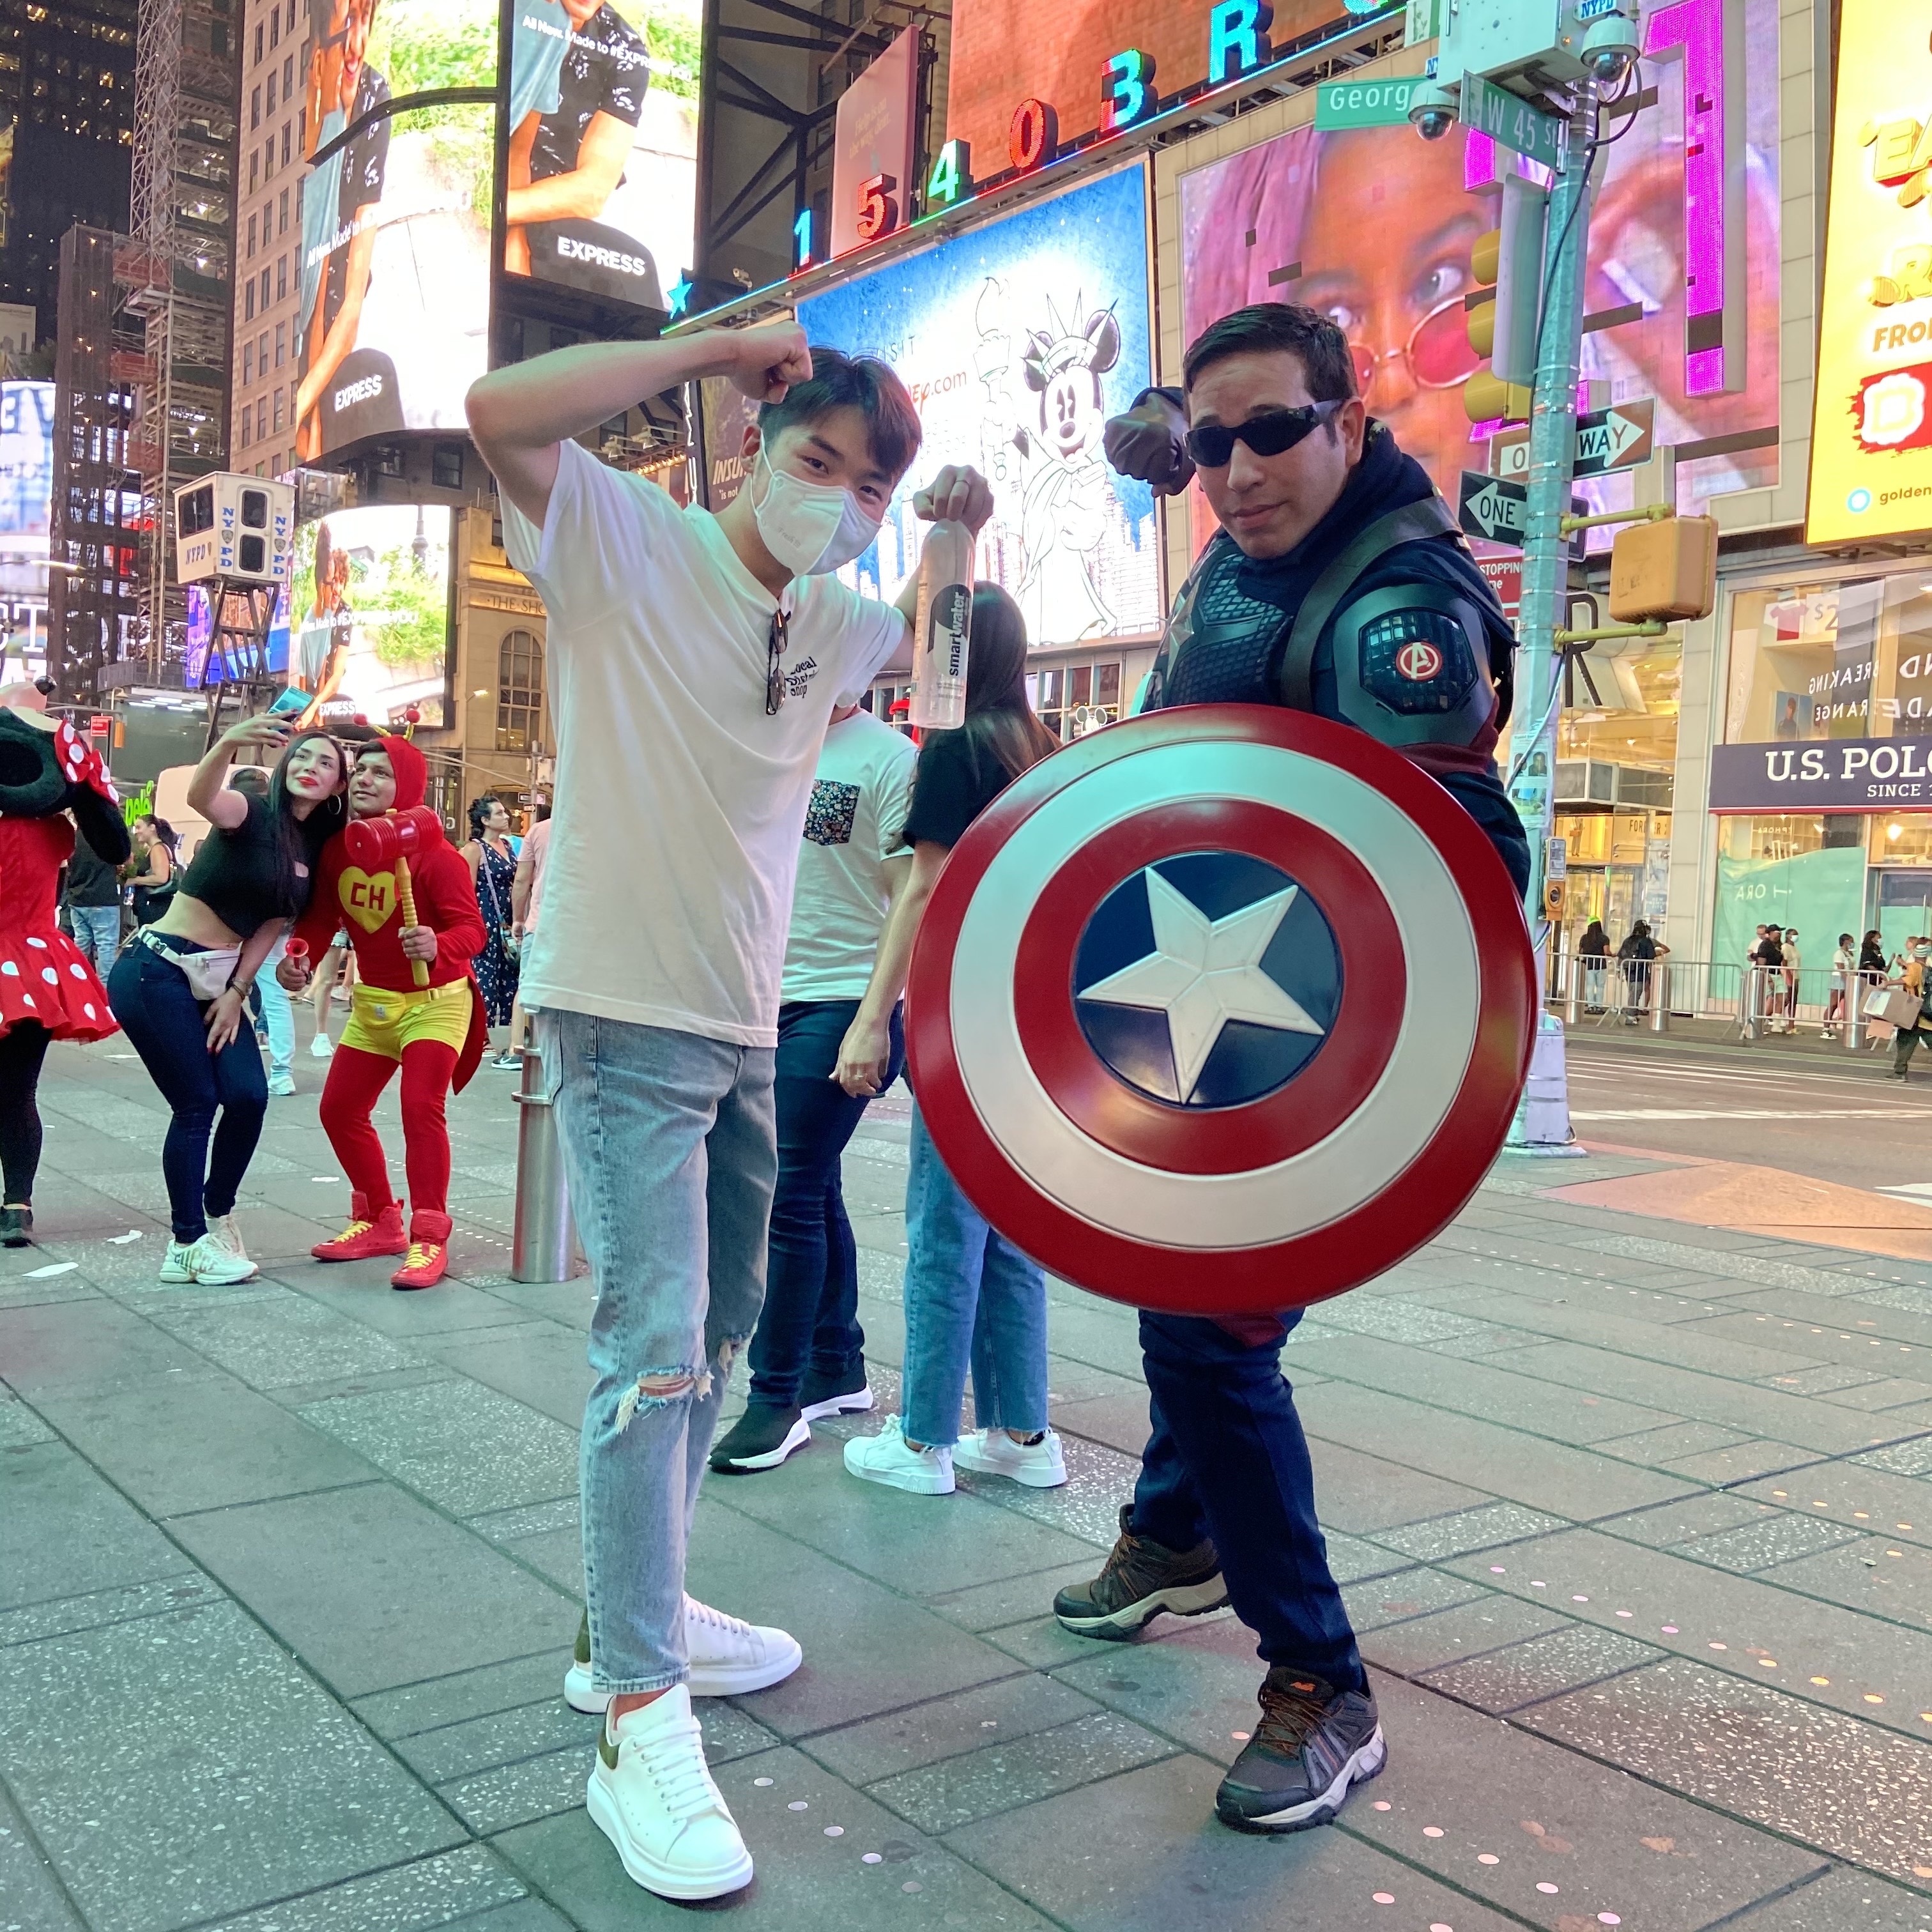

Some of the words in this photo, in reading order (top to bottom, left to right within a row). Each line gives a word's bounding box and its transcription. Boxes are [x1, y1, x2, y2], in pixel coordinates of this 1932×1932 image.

[565, 28, 595, 49] Made
[597, 41, 608, 54] to
[1330, 86, 1409, 111] Georg
[1488, 91, 1505, 135] W
[1514, 109, 1535, 151] 45
[557, 236, 645, 276] EXPRESS
[1873, 318, 1932, 352] FRO
[335, 374, 382, 412] EXPRESS
[1579, 424, 1628, 457] WAY
[713, 456, 747, 486] INSU
[728, 486, 738, 498] not
[1480, 495, 1516, 526] ONE
[186, 544, 206, 565] NYPD
[1479, 562, 1522, 576] STOPPIN
[490, 595, 516, 610] THE
[949, 592, 964, 676] smartwater
[319, 702, 355, 716] EXPRESS
[1765, 749, 1830, 781] U.S.
[1867, 784, 1921, 797] SINCE
[351, 882, 385, 911] CH
